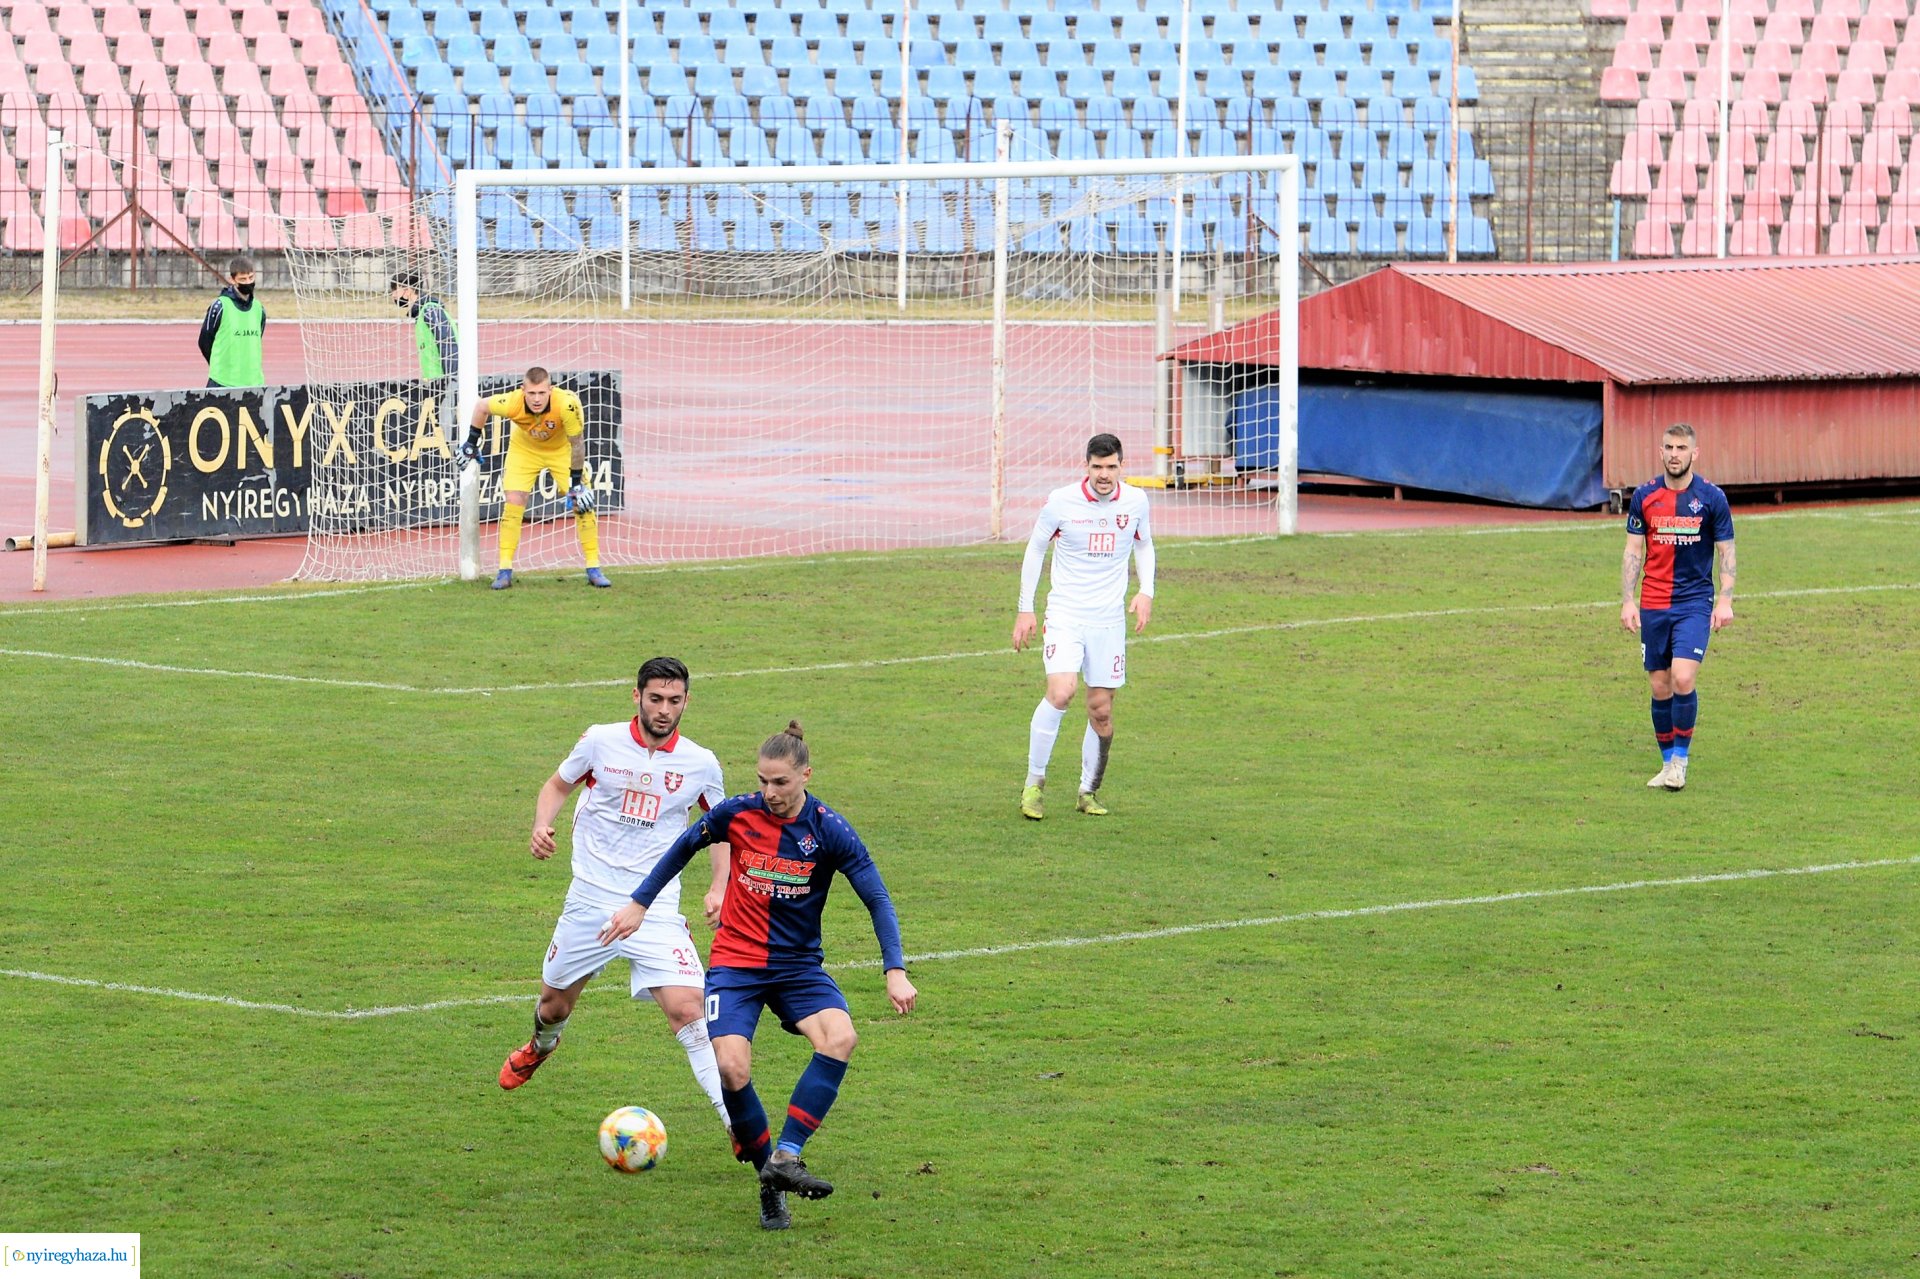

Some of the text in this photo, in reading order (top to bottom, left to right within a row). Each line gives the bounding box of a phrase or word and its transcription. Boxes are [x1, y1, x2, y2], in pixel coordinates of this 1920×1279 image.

[189, 401, 358, 473] ONYX
[202, 477, 371, 521] NYÍREGYHÁZA
[385, 473, 507, 509] NYÍRPZA
[1090, 533, 1114, 551] HR
[624, 790, 660, 820] HR
[619, 815, 656, 829] MONTAGE
[739, 849, 816, 877] REVESZ
